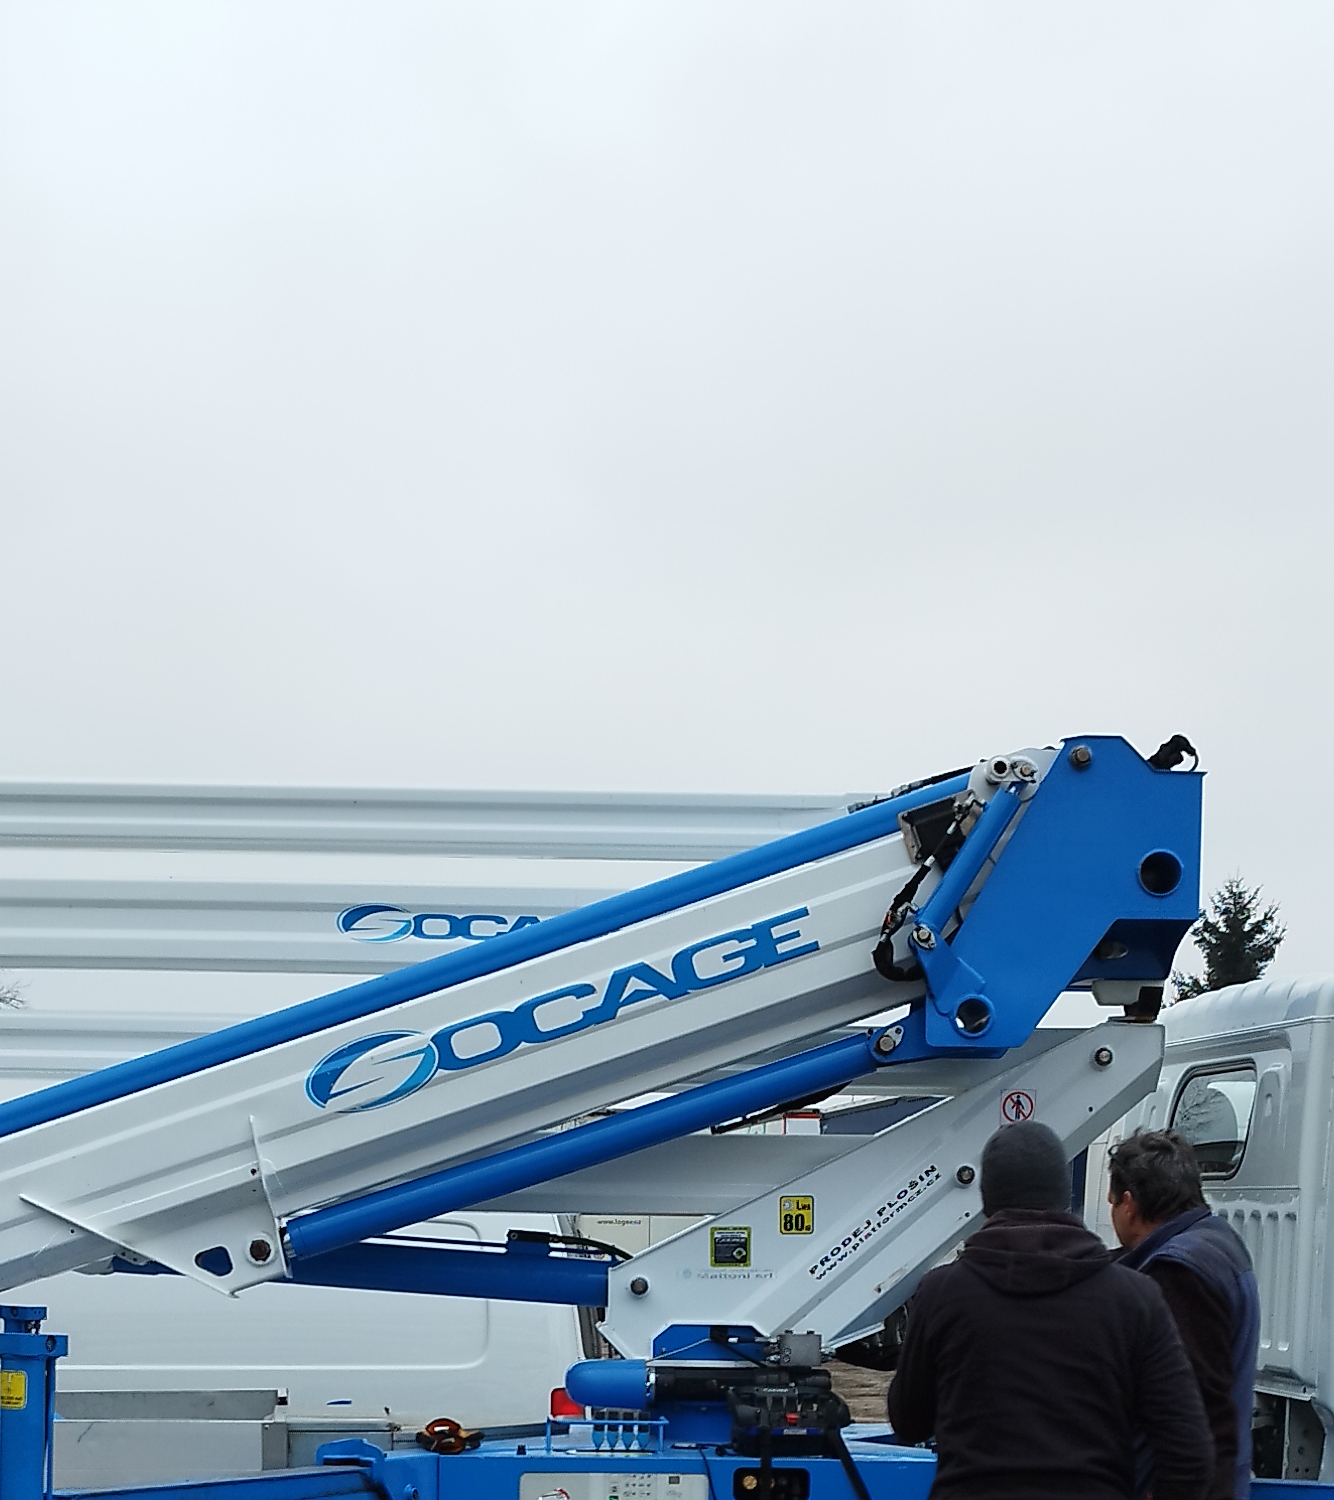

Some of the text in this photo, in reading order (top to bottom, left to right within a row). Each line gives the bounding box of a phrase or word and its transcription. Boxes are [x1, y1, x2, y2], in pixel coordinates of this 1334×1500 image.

[304, 905, 820, 1112] SOCAGE
[783, 1213, 805, 1231] 80
[809, 1165, 937, 1275] PRODEJ PLOŠIN
